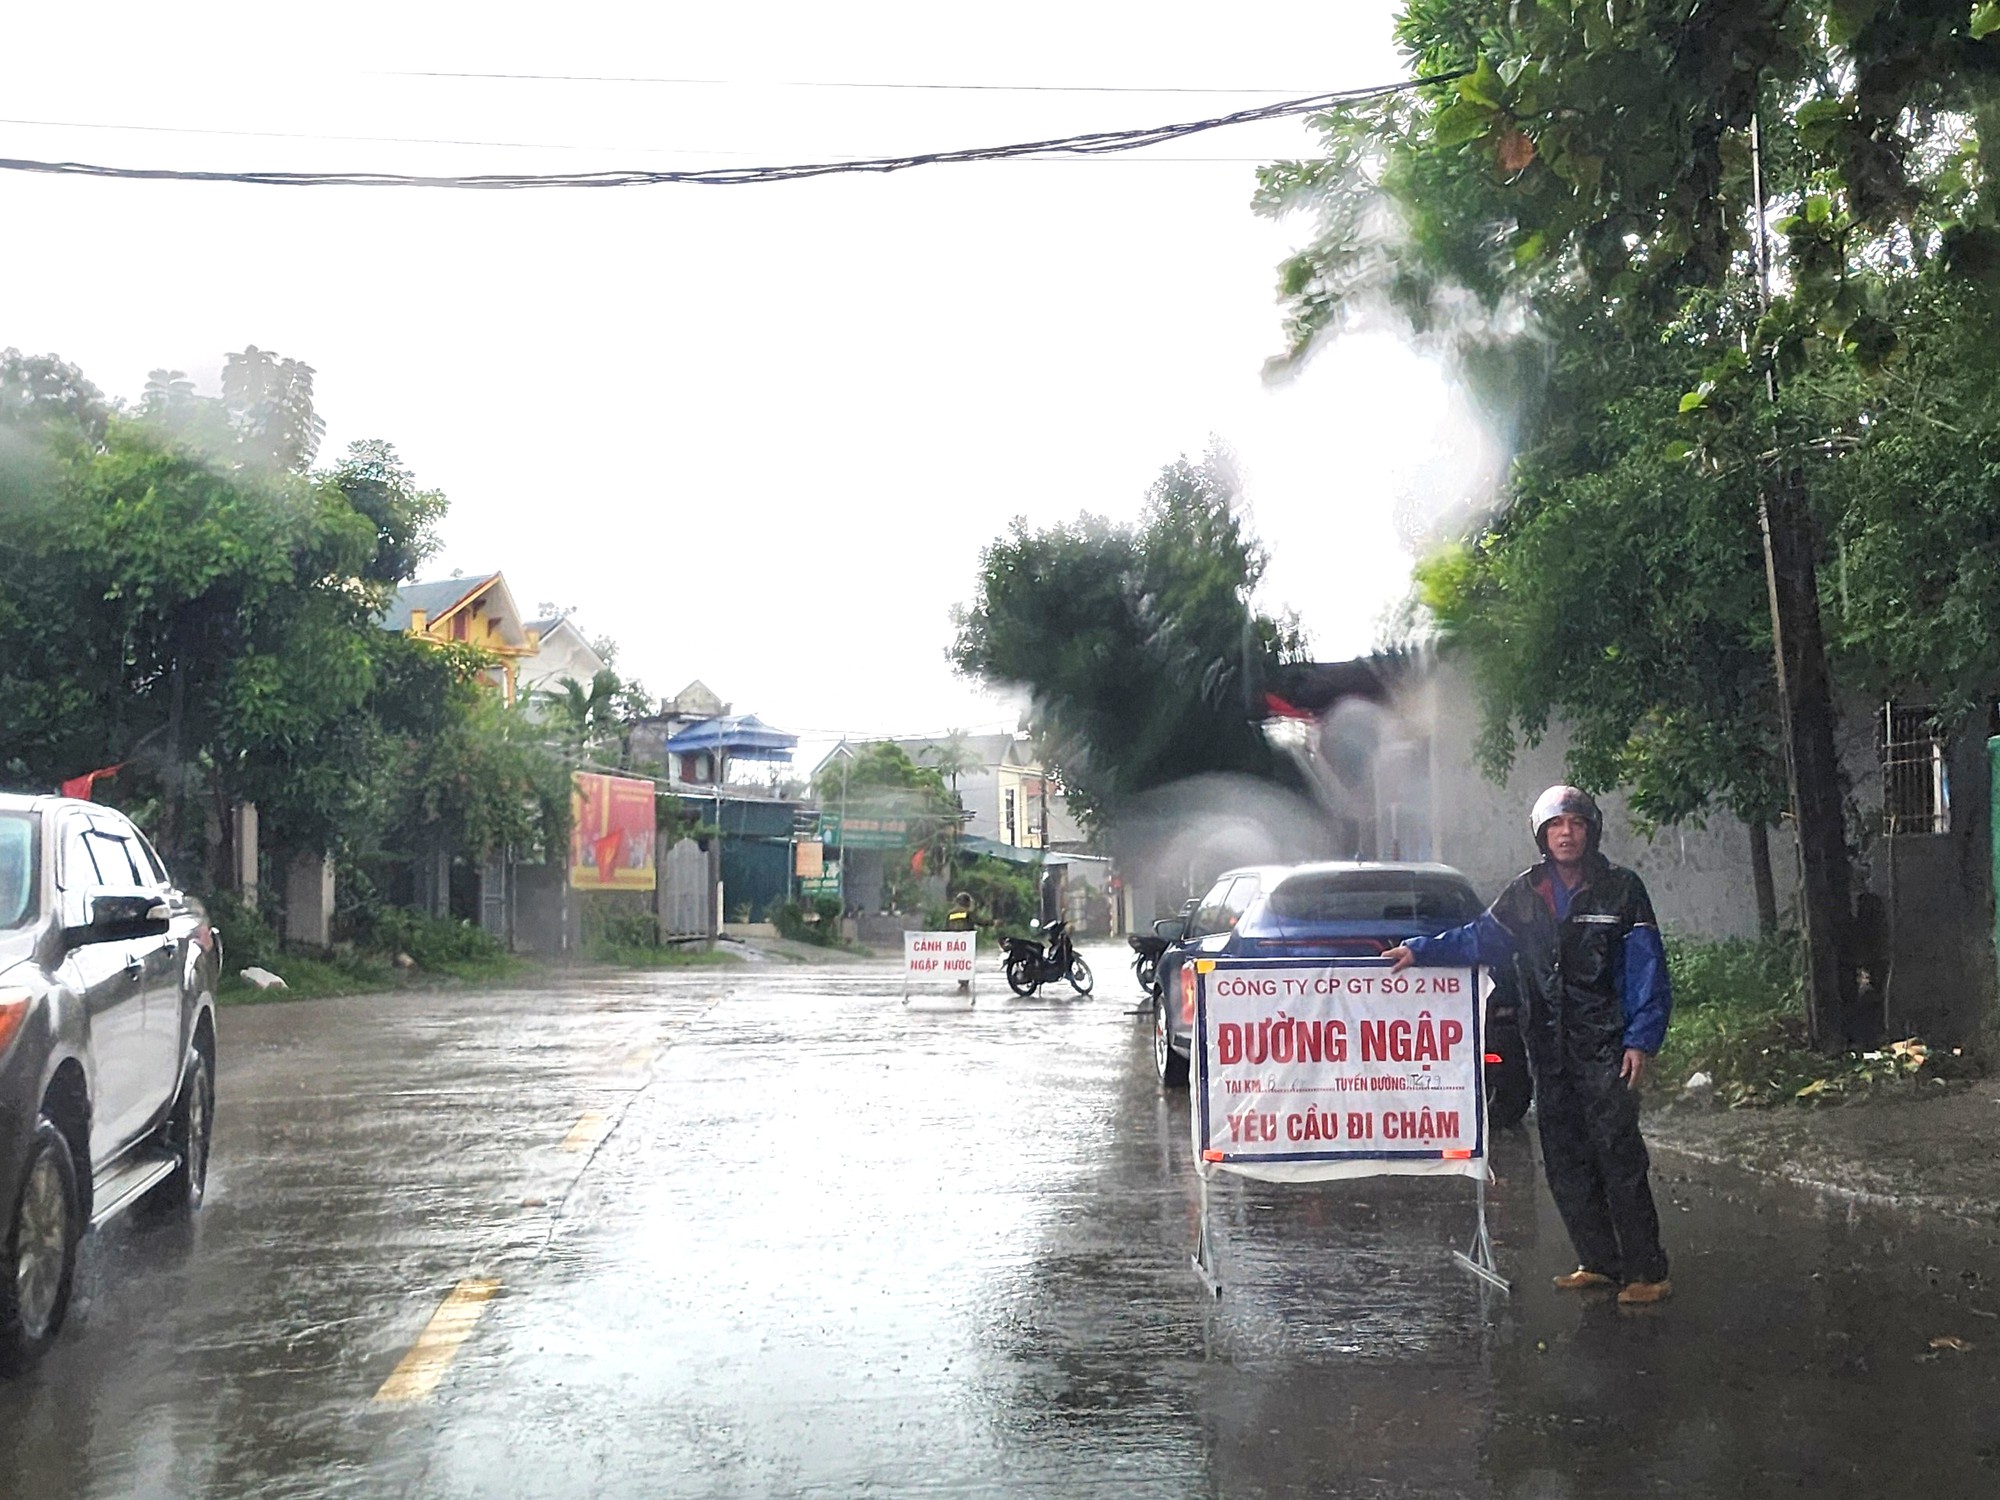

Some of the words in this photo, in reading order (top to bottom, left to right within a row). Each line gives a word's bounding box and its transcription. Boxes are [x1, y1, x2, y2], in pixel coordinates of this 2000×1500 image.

[946, 939, 967, 951] BÁO
[943, 956, 972, 971] NƯỚC
[1217, 977, 1277, 996] CÔNG
[1282, 979, 1308, 995] TY
[1314, 978, 1341, 995] CP
[1347, 978, 1374, 994] GT
[1415, 978, 1426, 994] 2
[1433, 978, 1460, 994] NB
[1217, 1011, 1347, 1065] ĐƯỜNG
[1360, 1011, 1463, 1071] NGẬP
[1225, 1080, 1242, 1097] TẠI
[1244, 1079, 1261, 1094] KM
[1227, 1108, 1277, 1142] YÊU
[1286, 1102, 1338, 1142] CẦU
[1346, 1112, 1373, 1140] ĐI
[1382, 1105, 1460, 1145] CHẬM
